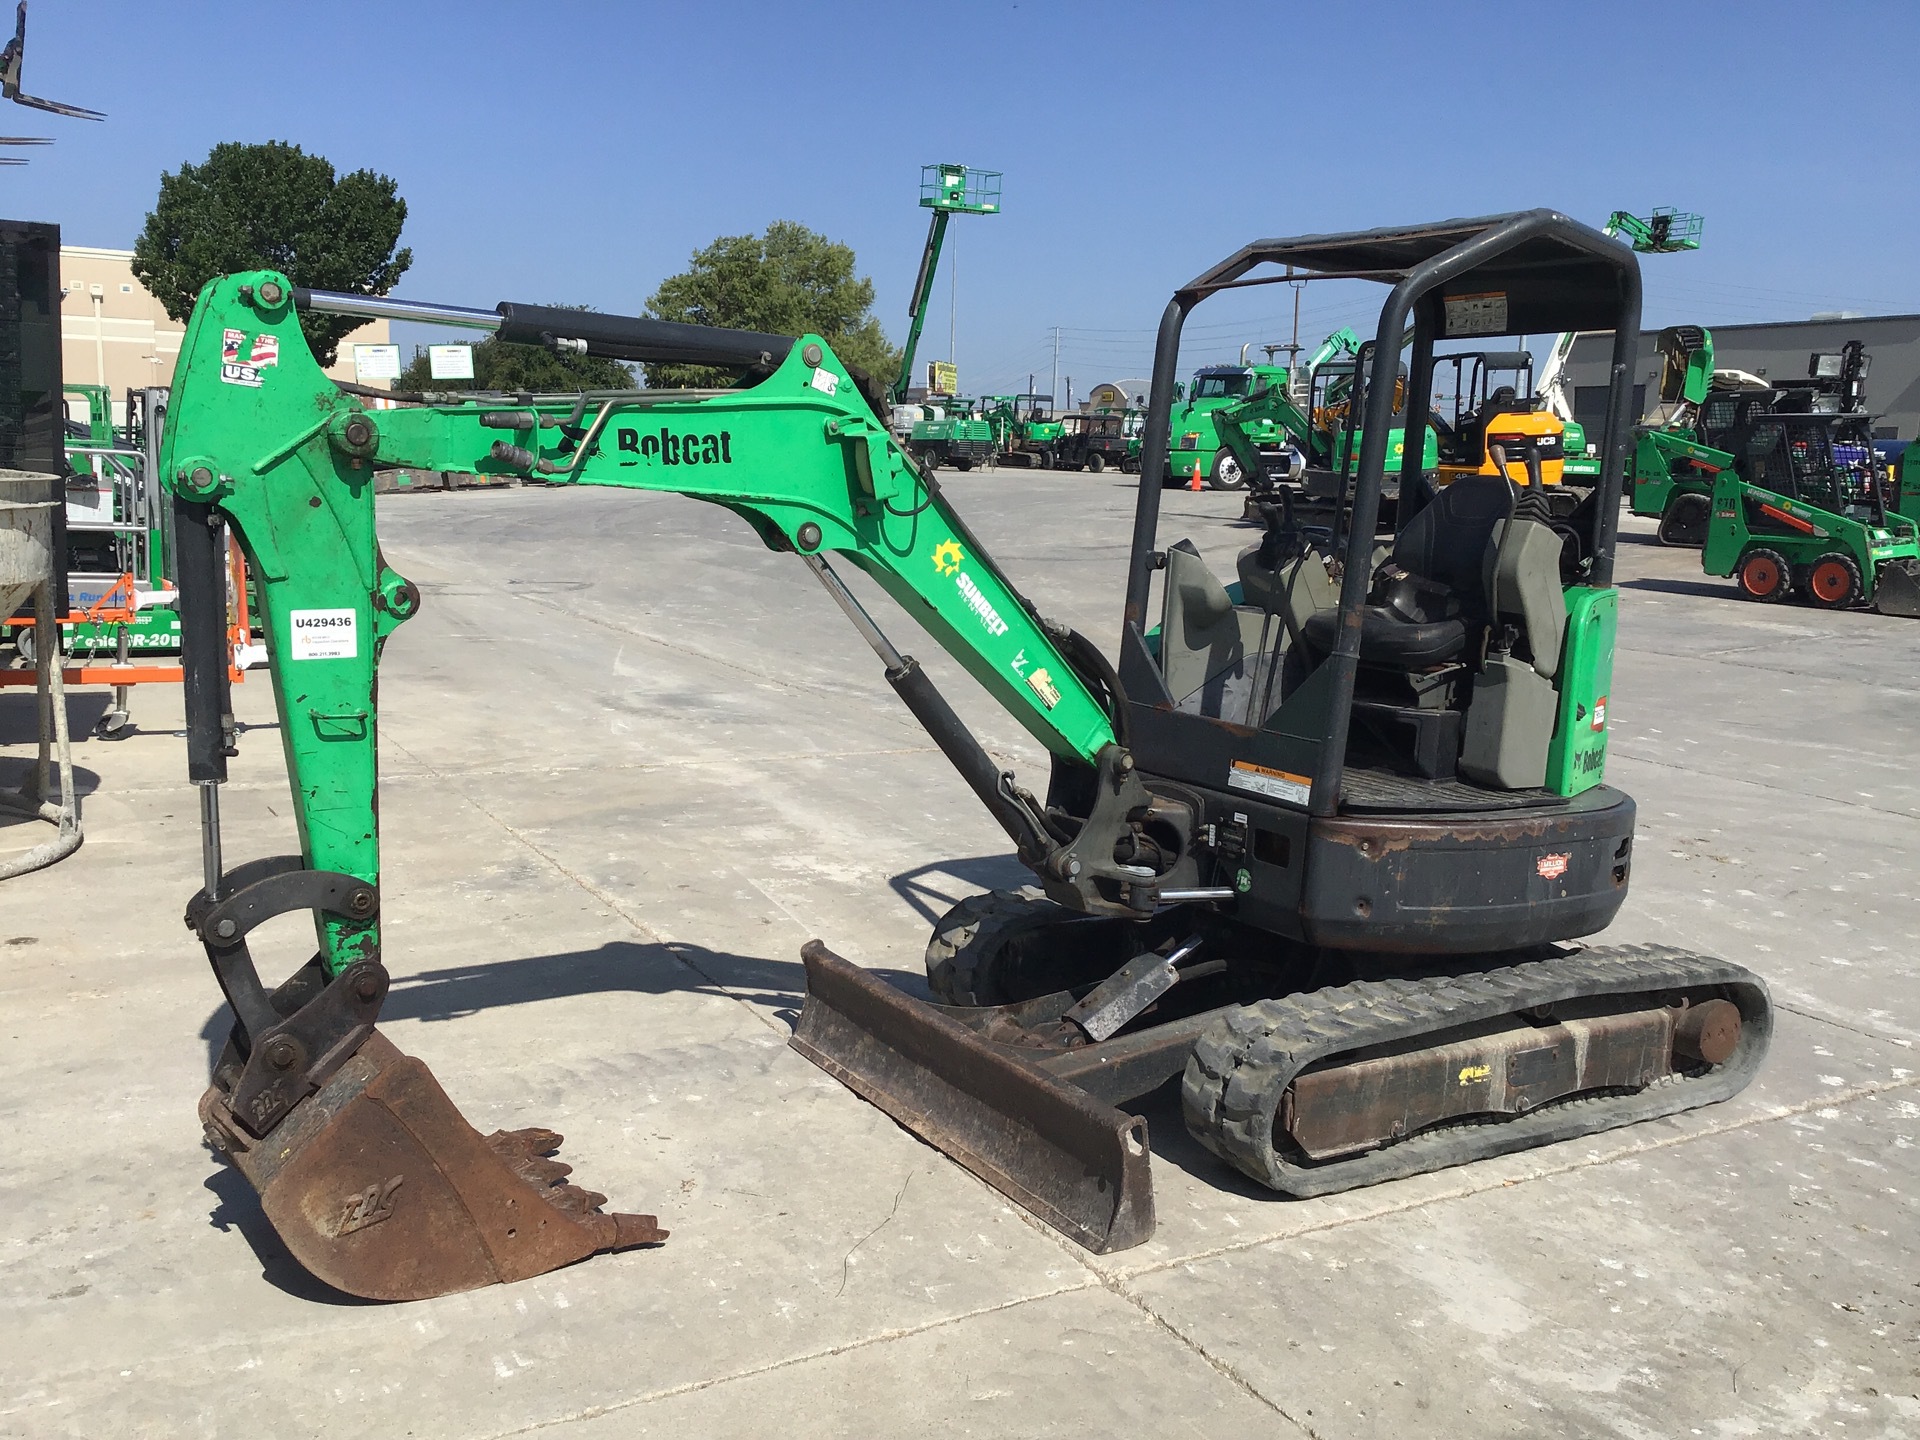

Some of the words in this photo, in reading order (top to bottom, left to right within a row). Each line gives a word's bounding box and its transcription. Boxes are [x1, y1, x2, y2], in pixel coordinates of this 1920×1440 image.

[617, 427, 732, 467] Bobcat
[1537, 437, 1556, 446] JCB
[955, 571, 1009, 637] SUNBELT
[296, 617, 352, 628] U429436
[1261, 766, 1286, 779] WARNING
